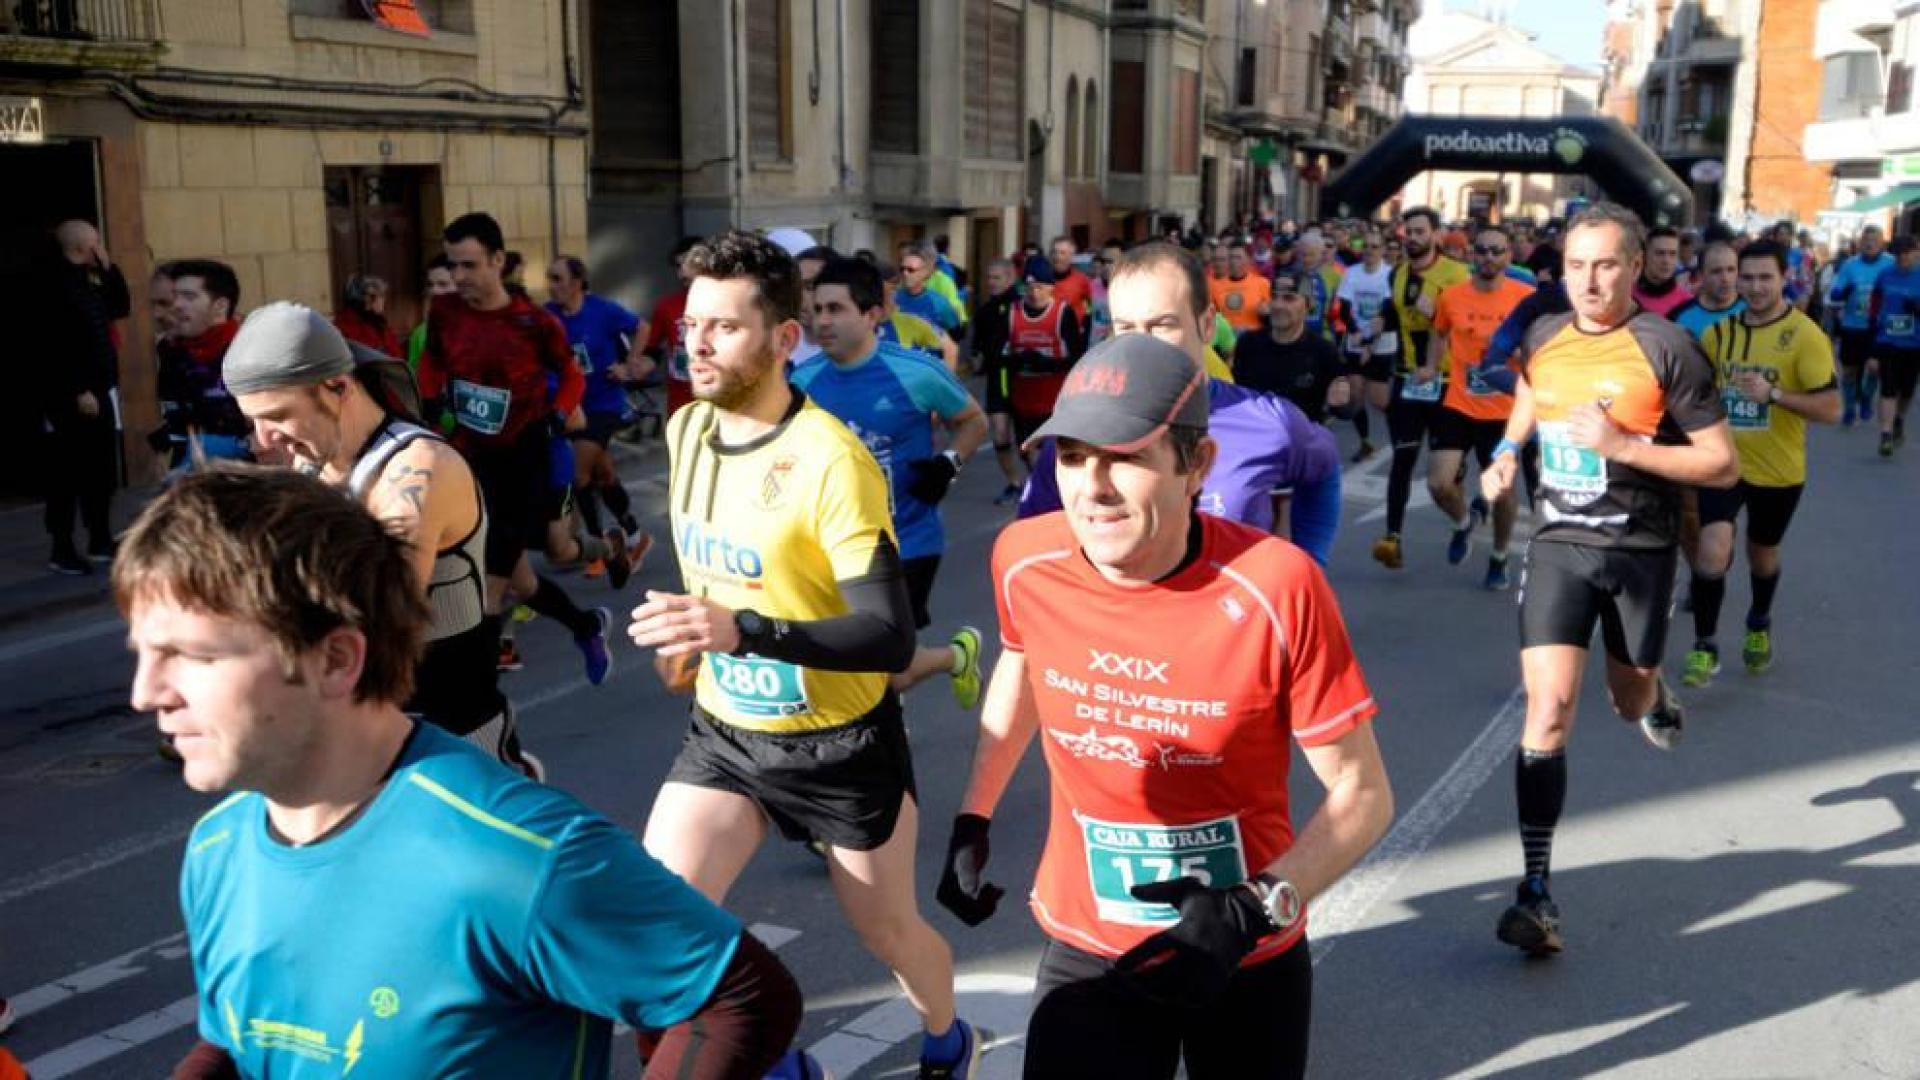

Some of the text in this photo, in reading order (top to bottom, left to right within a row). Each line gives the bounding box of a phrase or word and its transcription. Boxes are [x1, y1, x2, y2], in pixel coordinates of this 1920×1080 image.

[1424, 129, 1549, 160] podoactiva
[466, 398, 490, 418] 40
[1726, 400, 1761, 418] 148
[1552, 447, 1582, 472] 19
[674, 522, 764, 580] Virto
[714, 657, 781, 698] 280
[1087, 648, 1169, 684] XXIX
[1044, 667, 1228, 718] SAN SILVESTRE
[1075, 703, 1189, 739] DE LERÍN
[1146, 827, 1226, 848] RURAL
[1110, 856, 1212, 898] 175
